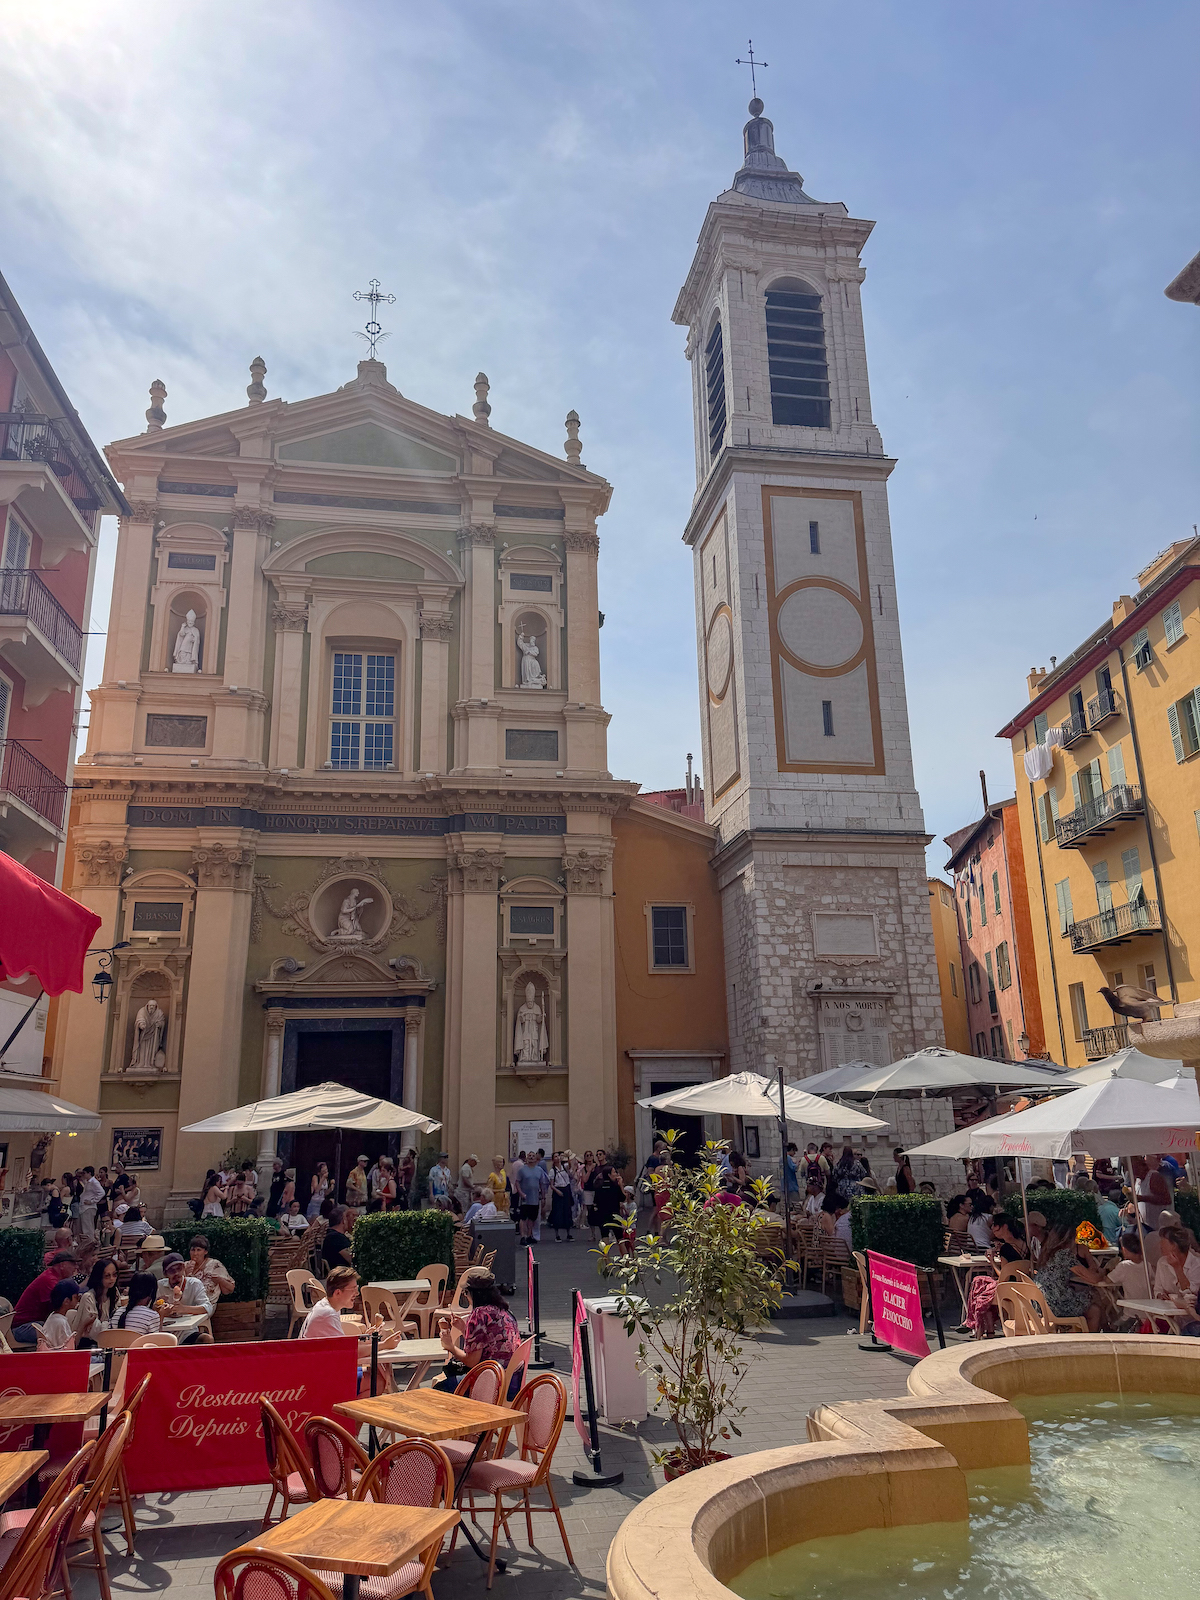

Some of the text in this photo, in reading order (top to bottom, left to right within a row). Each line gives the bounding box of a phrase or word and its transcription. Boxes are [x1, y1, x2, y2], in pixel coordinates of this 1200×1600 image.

[211, 809, 232, 821] IN
[265, 815, 340, 829] HONOREM
[833, 1001, 851, 1009] NOS
[854, 1001, 884, 1010] MORTS
[883, 1290, 906, 1310] GLACIER
[882, 1307, 913, 1331] FENOCCHIO
[176, 1384, 307, 1409] Restaurant
[167, 1414, 252, 1446] Depuis
